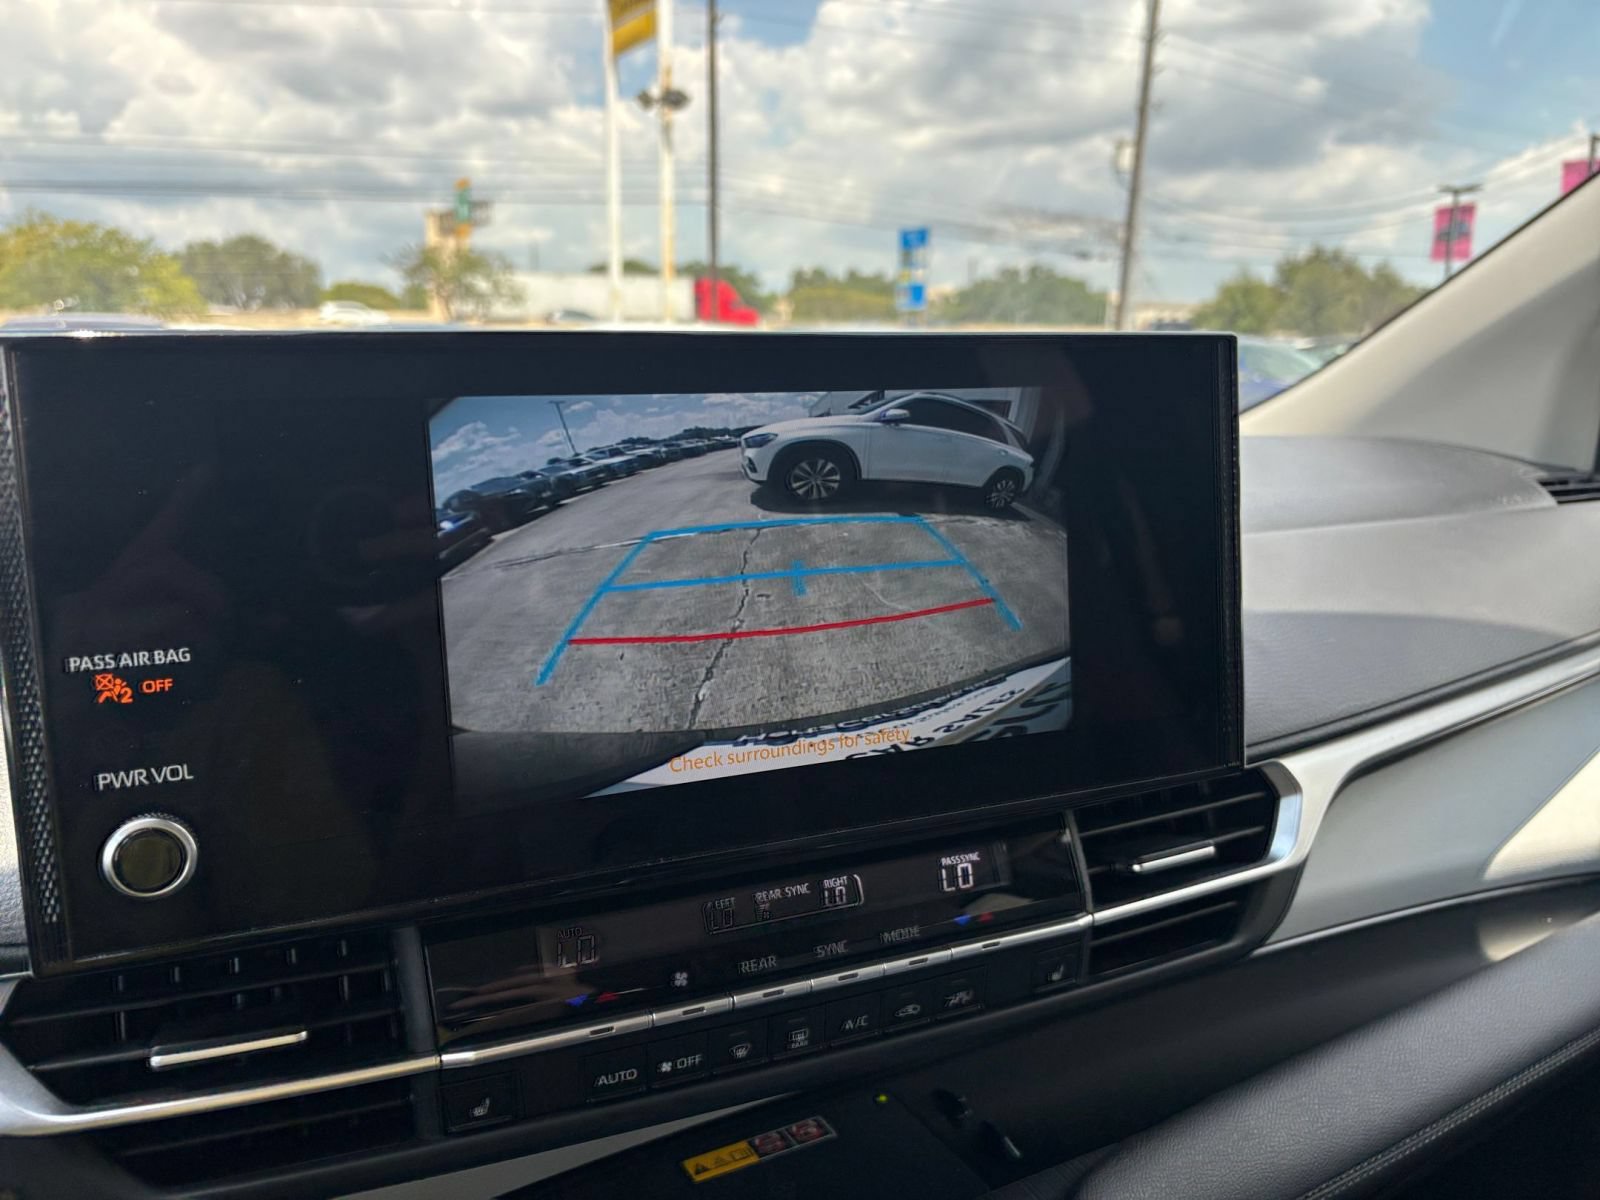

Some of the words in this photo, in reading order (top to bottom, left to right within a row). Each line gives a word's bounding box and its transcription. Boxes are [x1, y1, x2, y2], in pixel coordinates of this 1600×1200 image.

[68, 654, 115, 673] PASS
[117, 650, 151, 668] AIR
[153, 648, 191, 665] BAG
[142, 678, 173, 693] OFF
[668, 753, 724, 774] Check
[726, 736, 836, 766] surroundings
[837, 732, 862, 750] for
[864, 726, 912, 748] safety
[96, 767, 150, 791] PWR
[151, 764, 194, 783] VOL
[822, 875, 849, 889] RIGHT
[754, 890, 782, 903] REAR
[784, 882, 811, 898] SYNC
[814, 939, 849, 958] SYNC
[739, 955, 777, 974] REAR
[675, 1054, 702, 1070] OFF
[595, 1068, 638, 1087] AUTO
